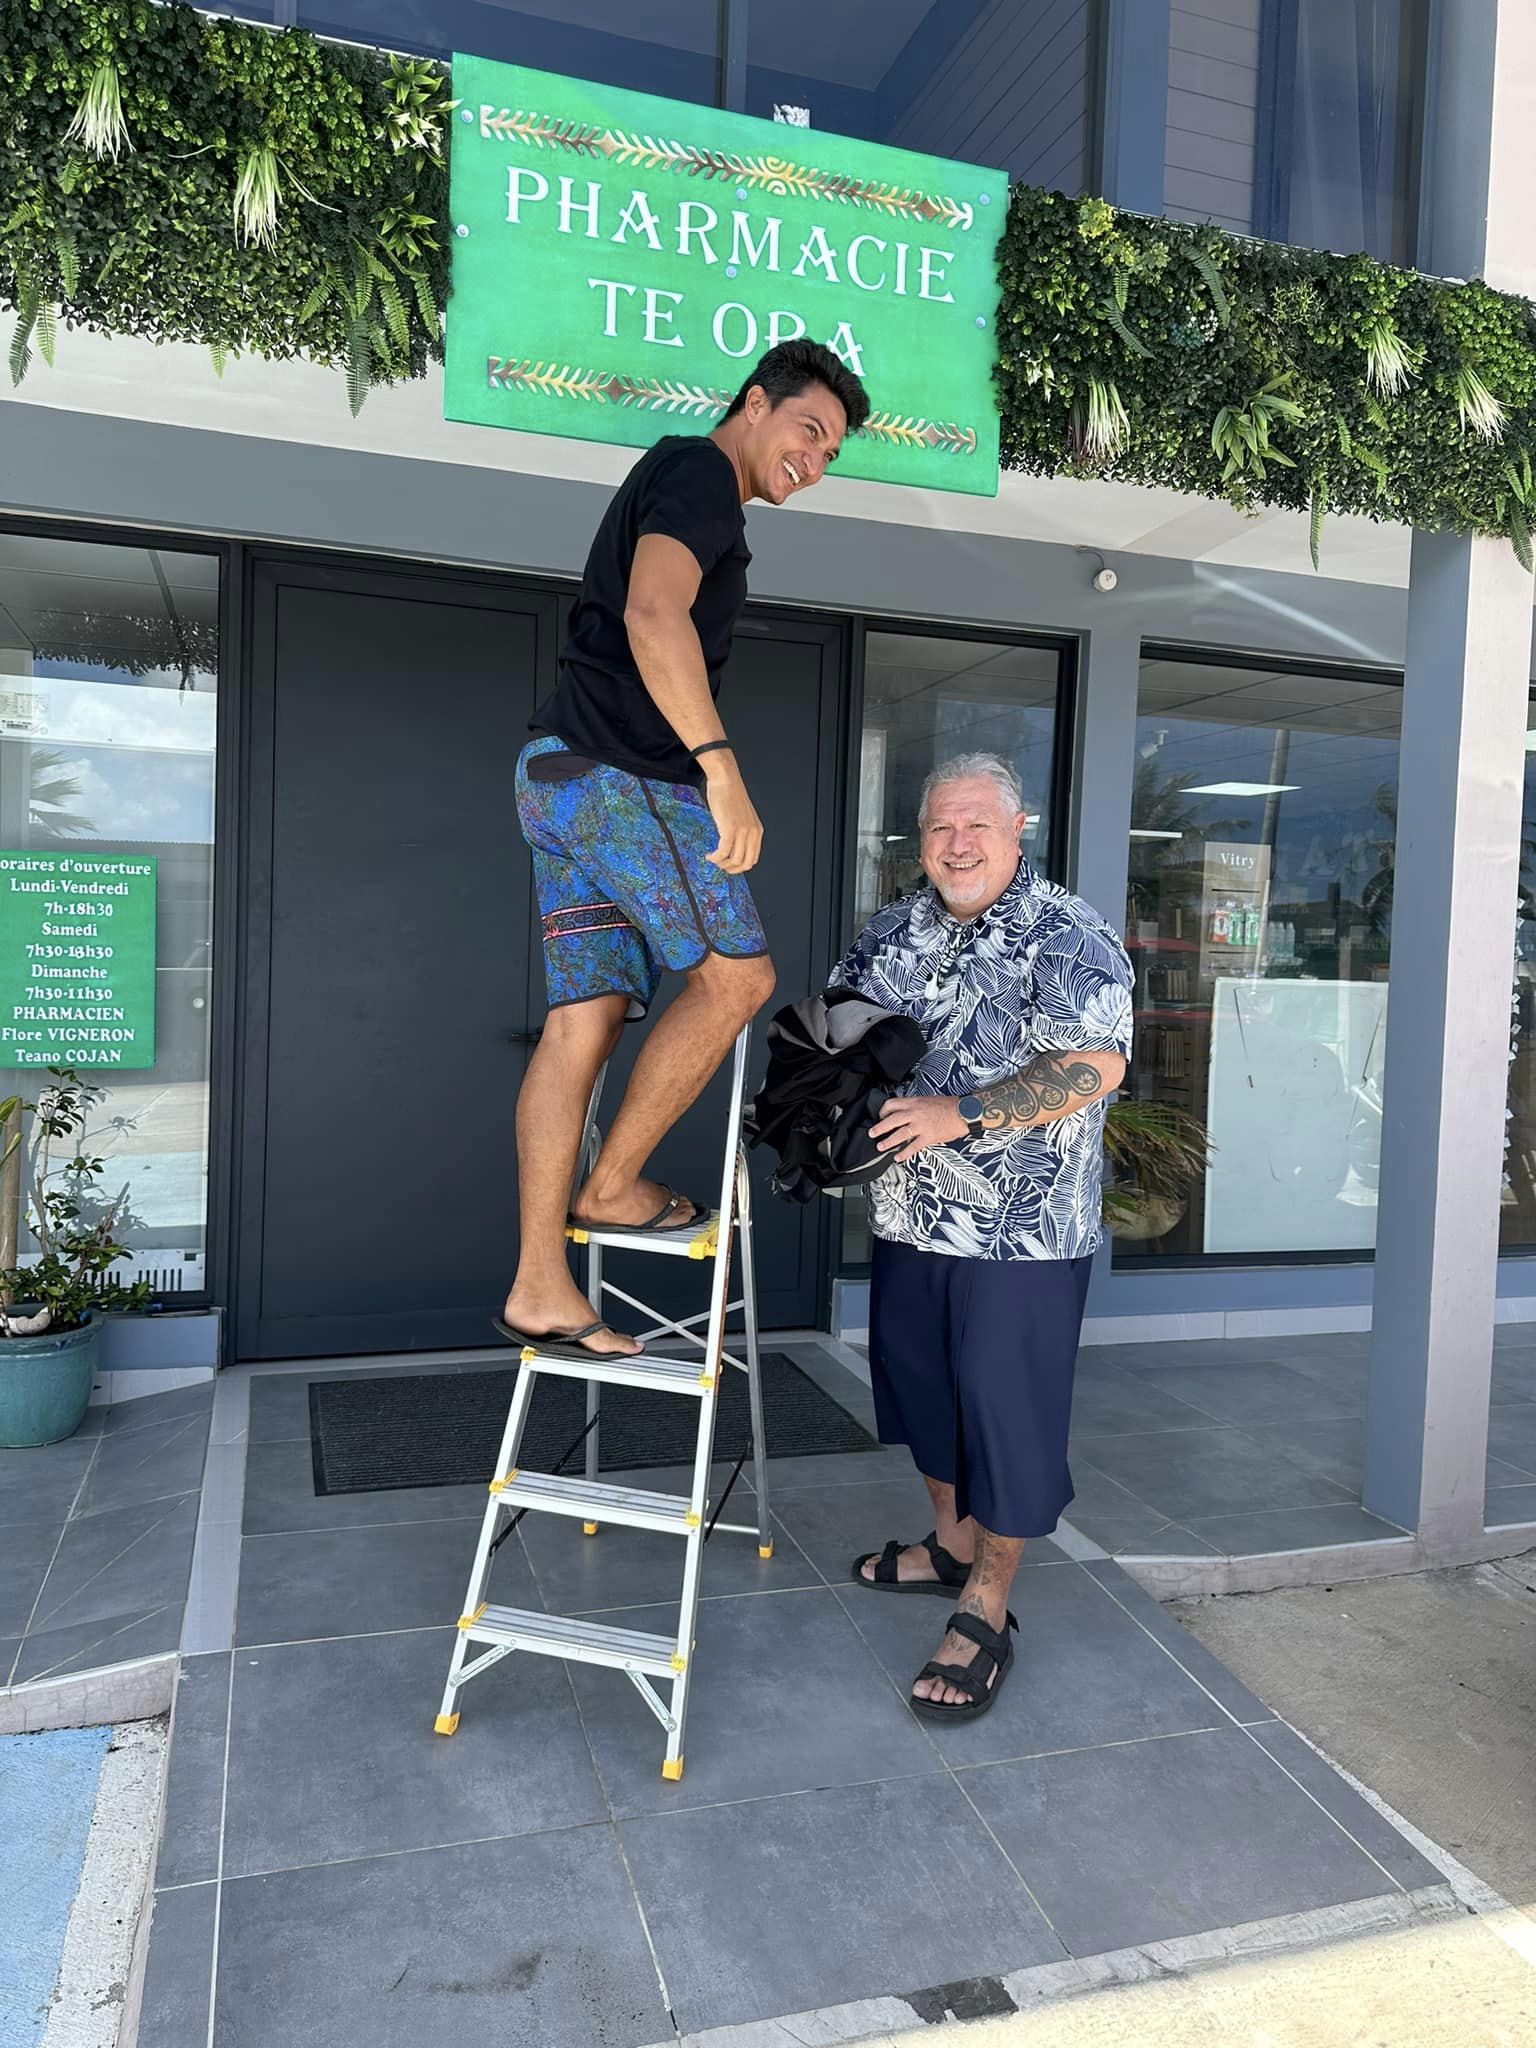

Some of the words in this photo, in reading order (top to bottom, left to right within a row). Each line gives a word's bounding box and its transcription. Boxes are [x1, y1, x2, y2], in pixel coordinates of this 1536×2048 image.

[505, 166, 956, 303] PHARMACIE
[587, 278, 685, 347] TE
[60, 859, 151, 875] d'ouverture
[1220, 852, 1256, 870] Vitry
[10, 878, 129, 895] Lundi-Vendredi
[41, 922, 98, 936] Samedi
[25, 944, 113, 959] 7h30-18h30
[31, 964, 108, 979] Dimanche
[25, 986, 113, 1001] 7h30-11h30
[13, 1006, 125, 1020] PHARMACIEN
[1, 1027, 42, 1041] Flore
[48, 1028, 135, 1041] VIGNERON
[15, 1049, 61, 1062] Teano
[65, 1049, 122, 1062] COJAN
